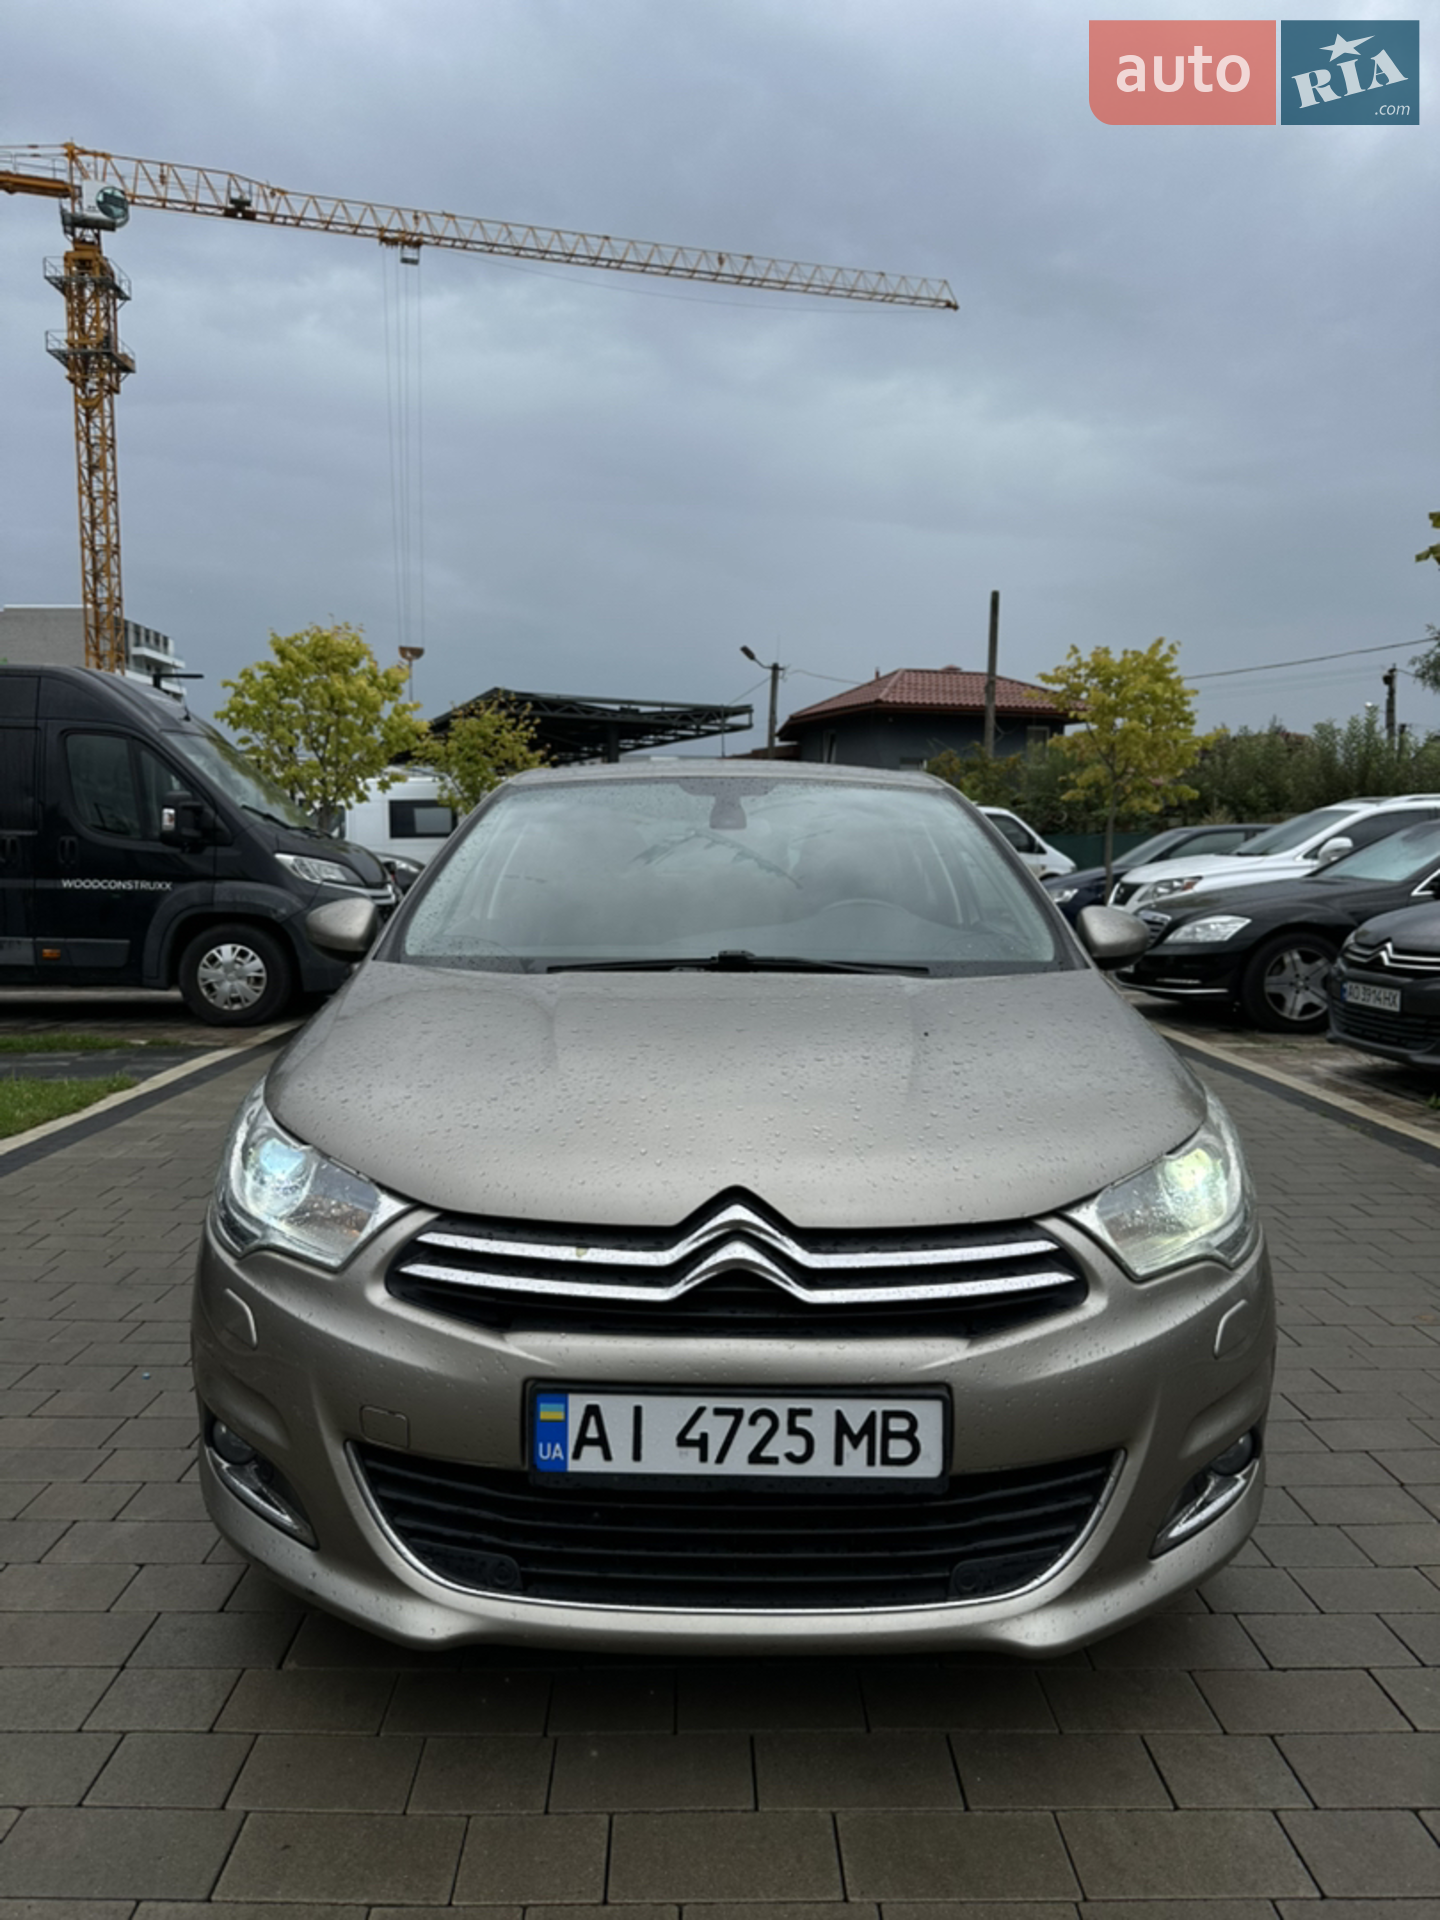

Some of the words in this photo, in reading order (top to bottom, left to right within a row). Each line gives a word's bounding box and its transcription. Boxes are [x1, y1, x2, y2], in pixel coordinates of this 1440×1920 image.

[61, 878, 172, 890] WOODCONSTRUXX
[572, 1404, 643, 1462] AI
[676, 1406, 815, 1464] 4725
[833, 1409, 922, 1467] MB
[539, 1443, 564, 1460] UA
